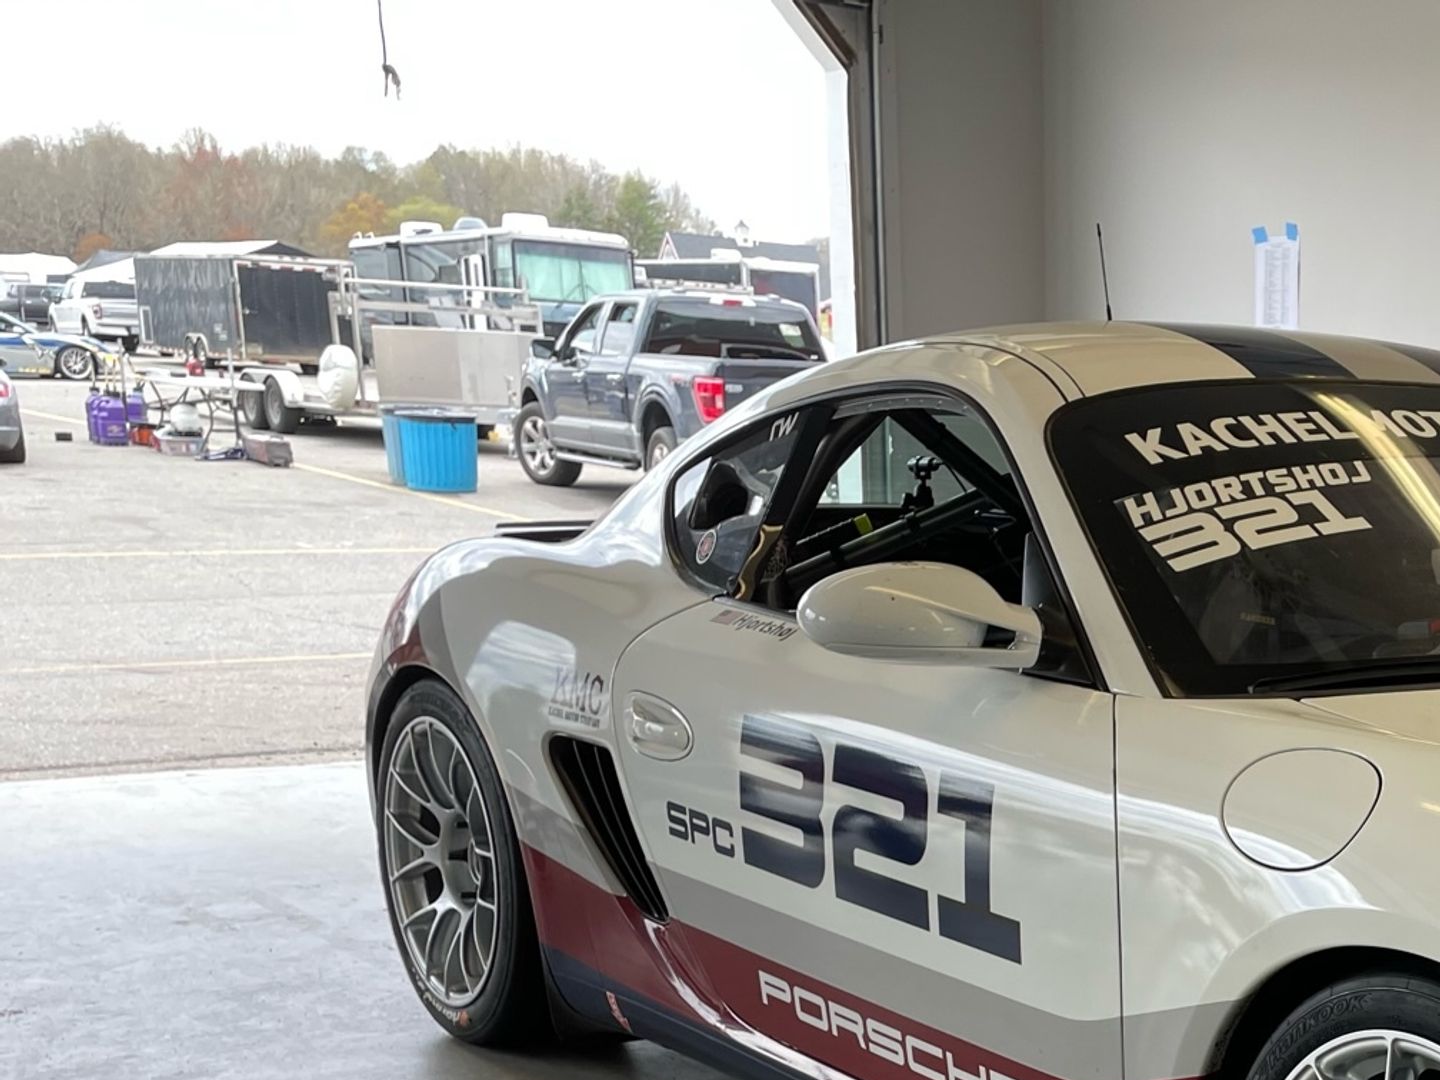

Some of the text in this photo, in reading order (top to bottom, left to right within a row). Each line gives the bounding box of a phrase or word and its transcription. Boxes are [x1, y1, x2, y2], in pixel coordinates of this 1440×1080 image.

[1124, 411, 1360, 465] KACHEL
[1124, 460, 1372, 528] HJORTSHOJ
[1138, 489, 1373, 573] 321
[550, 666, 604, 715] KMC
[666, 801, 735, 858] SPC
[739, 712, 1022, 965] 321
